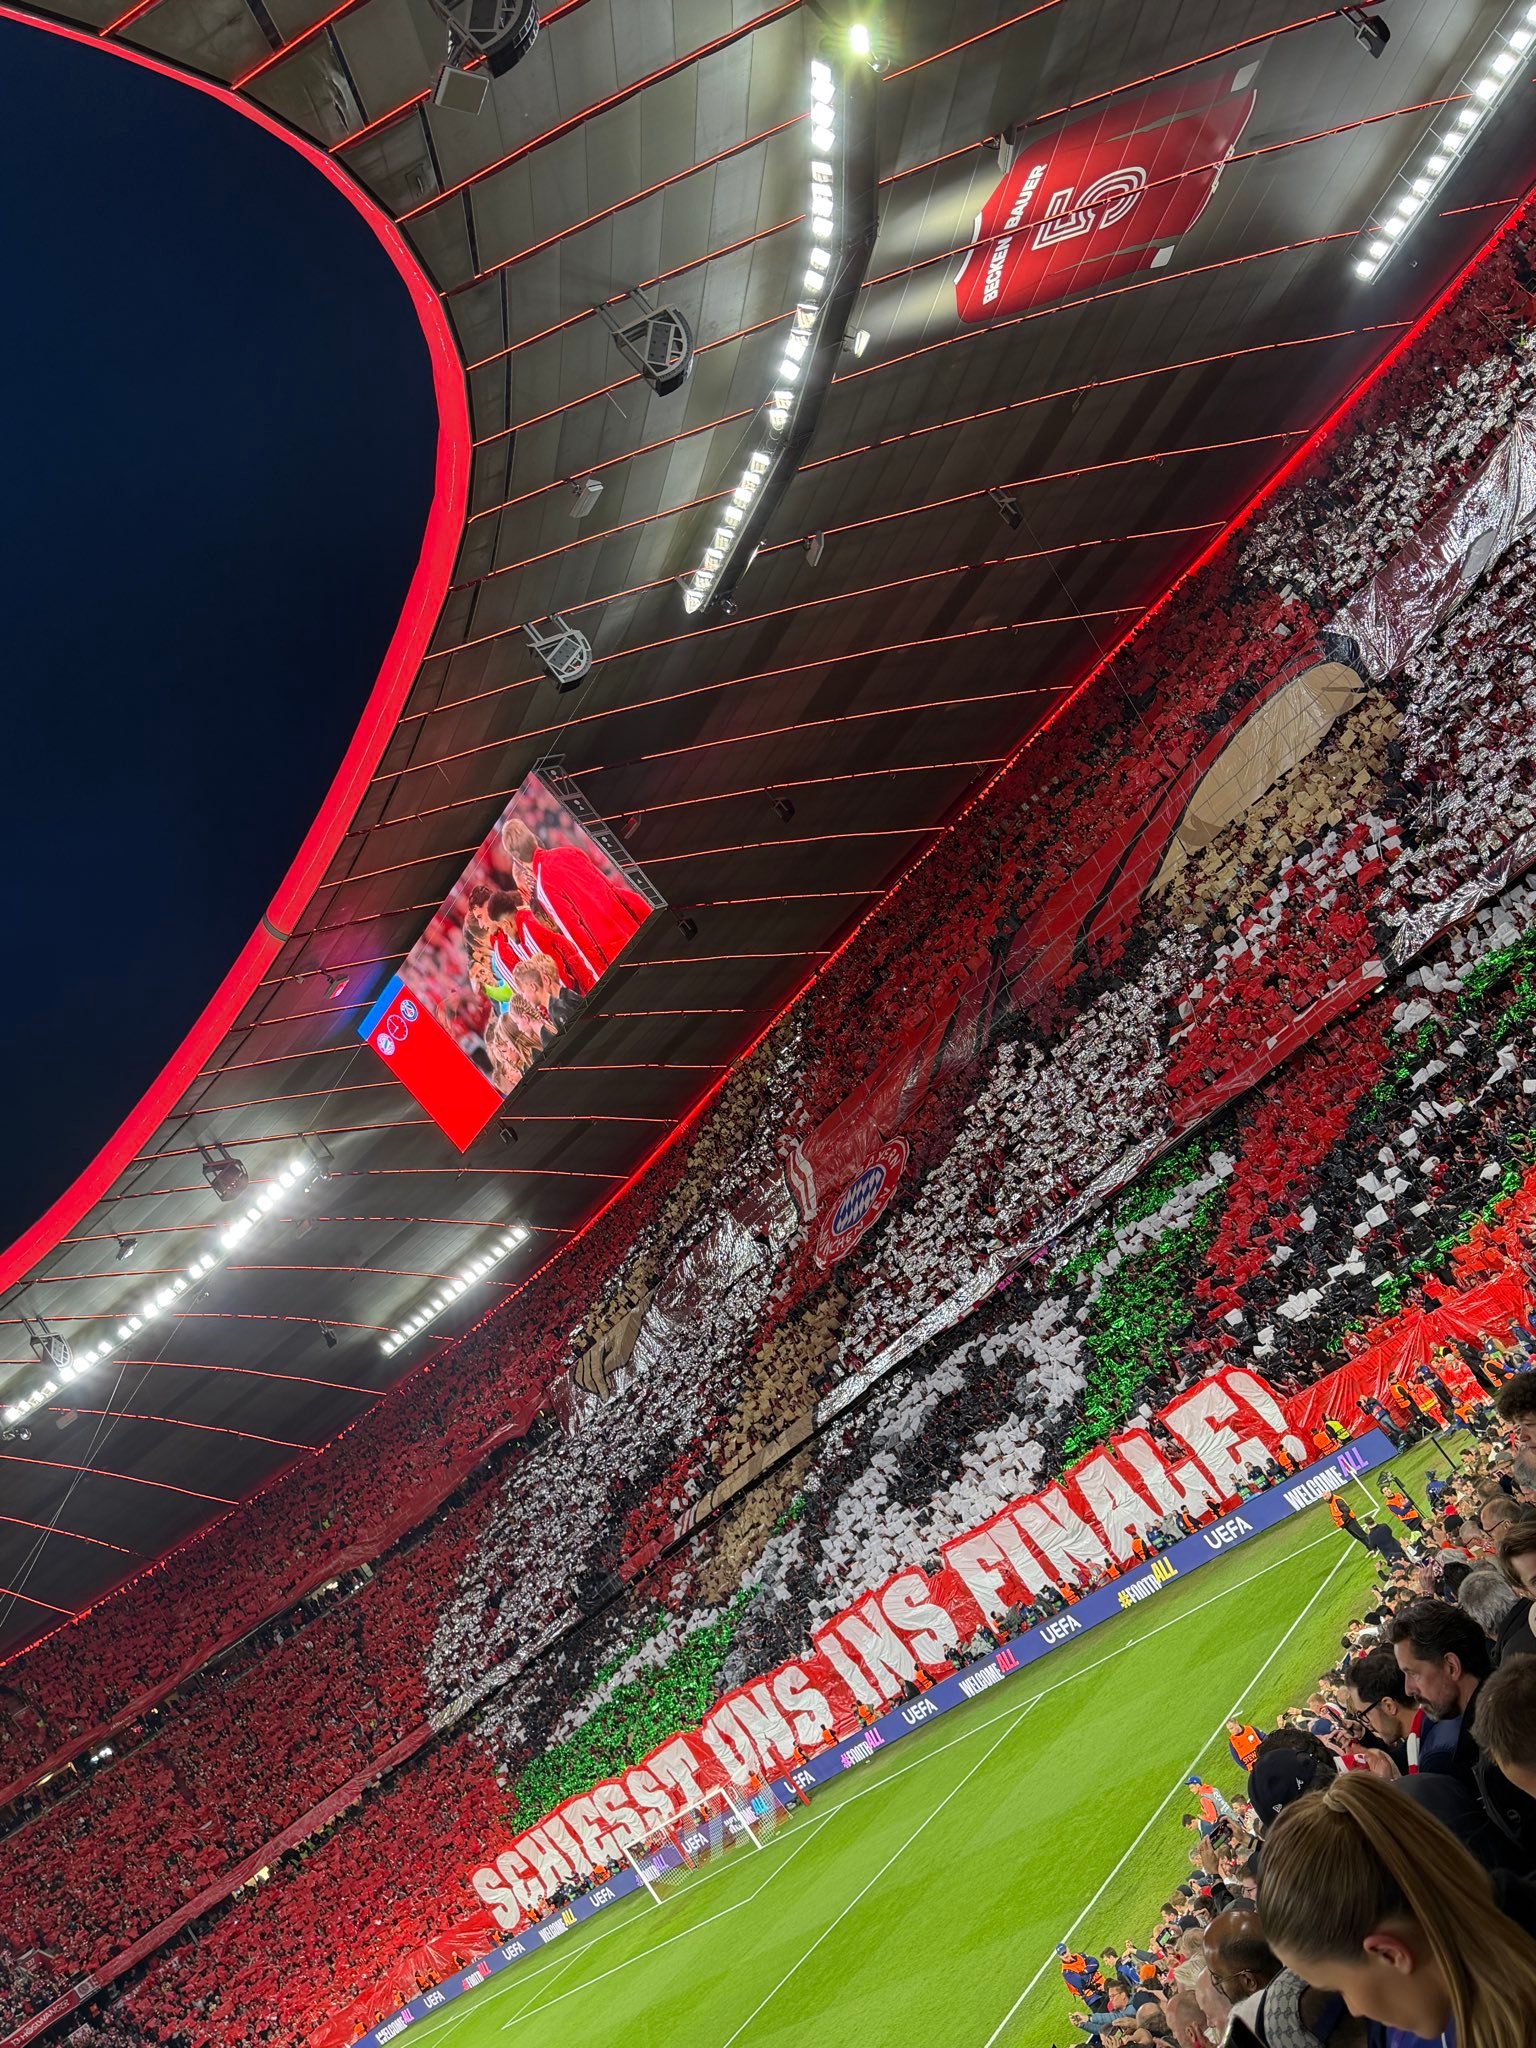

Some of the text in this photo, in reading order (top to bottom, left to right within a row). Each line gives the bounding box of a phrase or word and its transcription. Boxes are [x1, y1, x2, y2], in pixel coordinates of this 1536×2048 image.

[1031, 165, 1147, 250] 5
[1203, 1516, 1253, 1549] UEFA
[1040, 1614, 1082, 1644] UEFA
[472, 1371, 1308, 1930] SCHIESST UNS INS FINALE!
[901, 1698, 938, 1725] UEFA
[784, 1770, 816, 1794] UEFA
[681, 1832, 709, 1854] UEFA
[589, 1887, 616, 1907] UEFA
[501, 1942, 526, 1961] UEFA
[423, 1991, 446, 2009] UEFA
